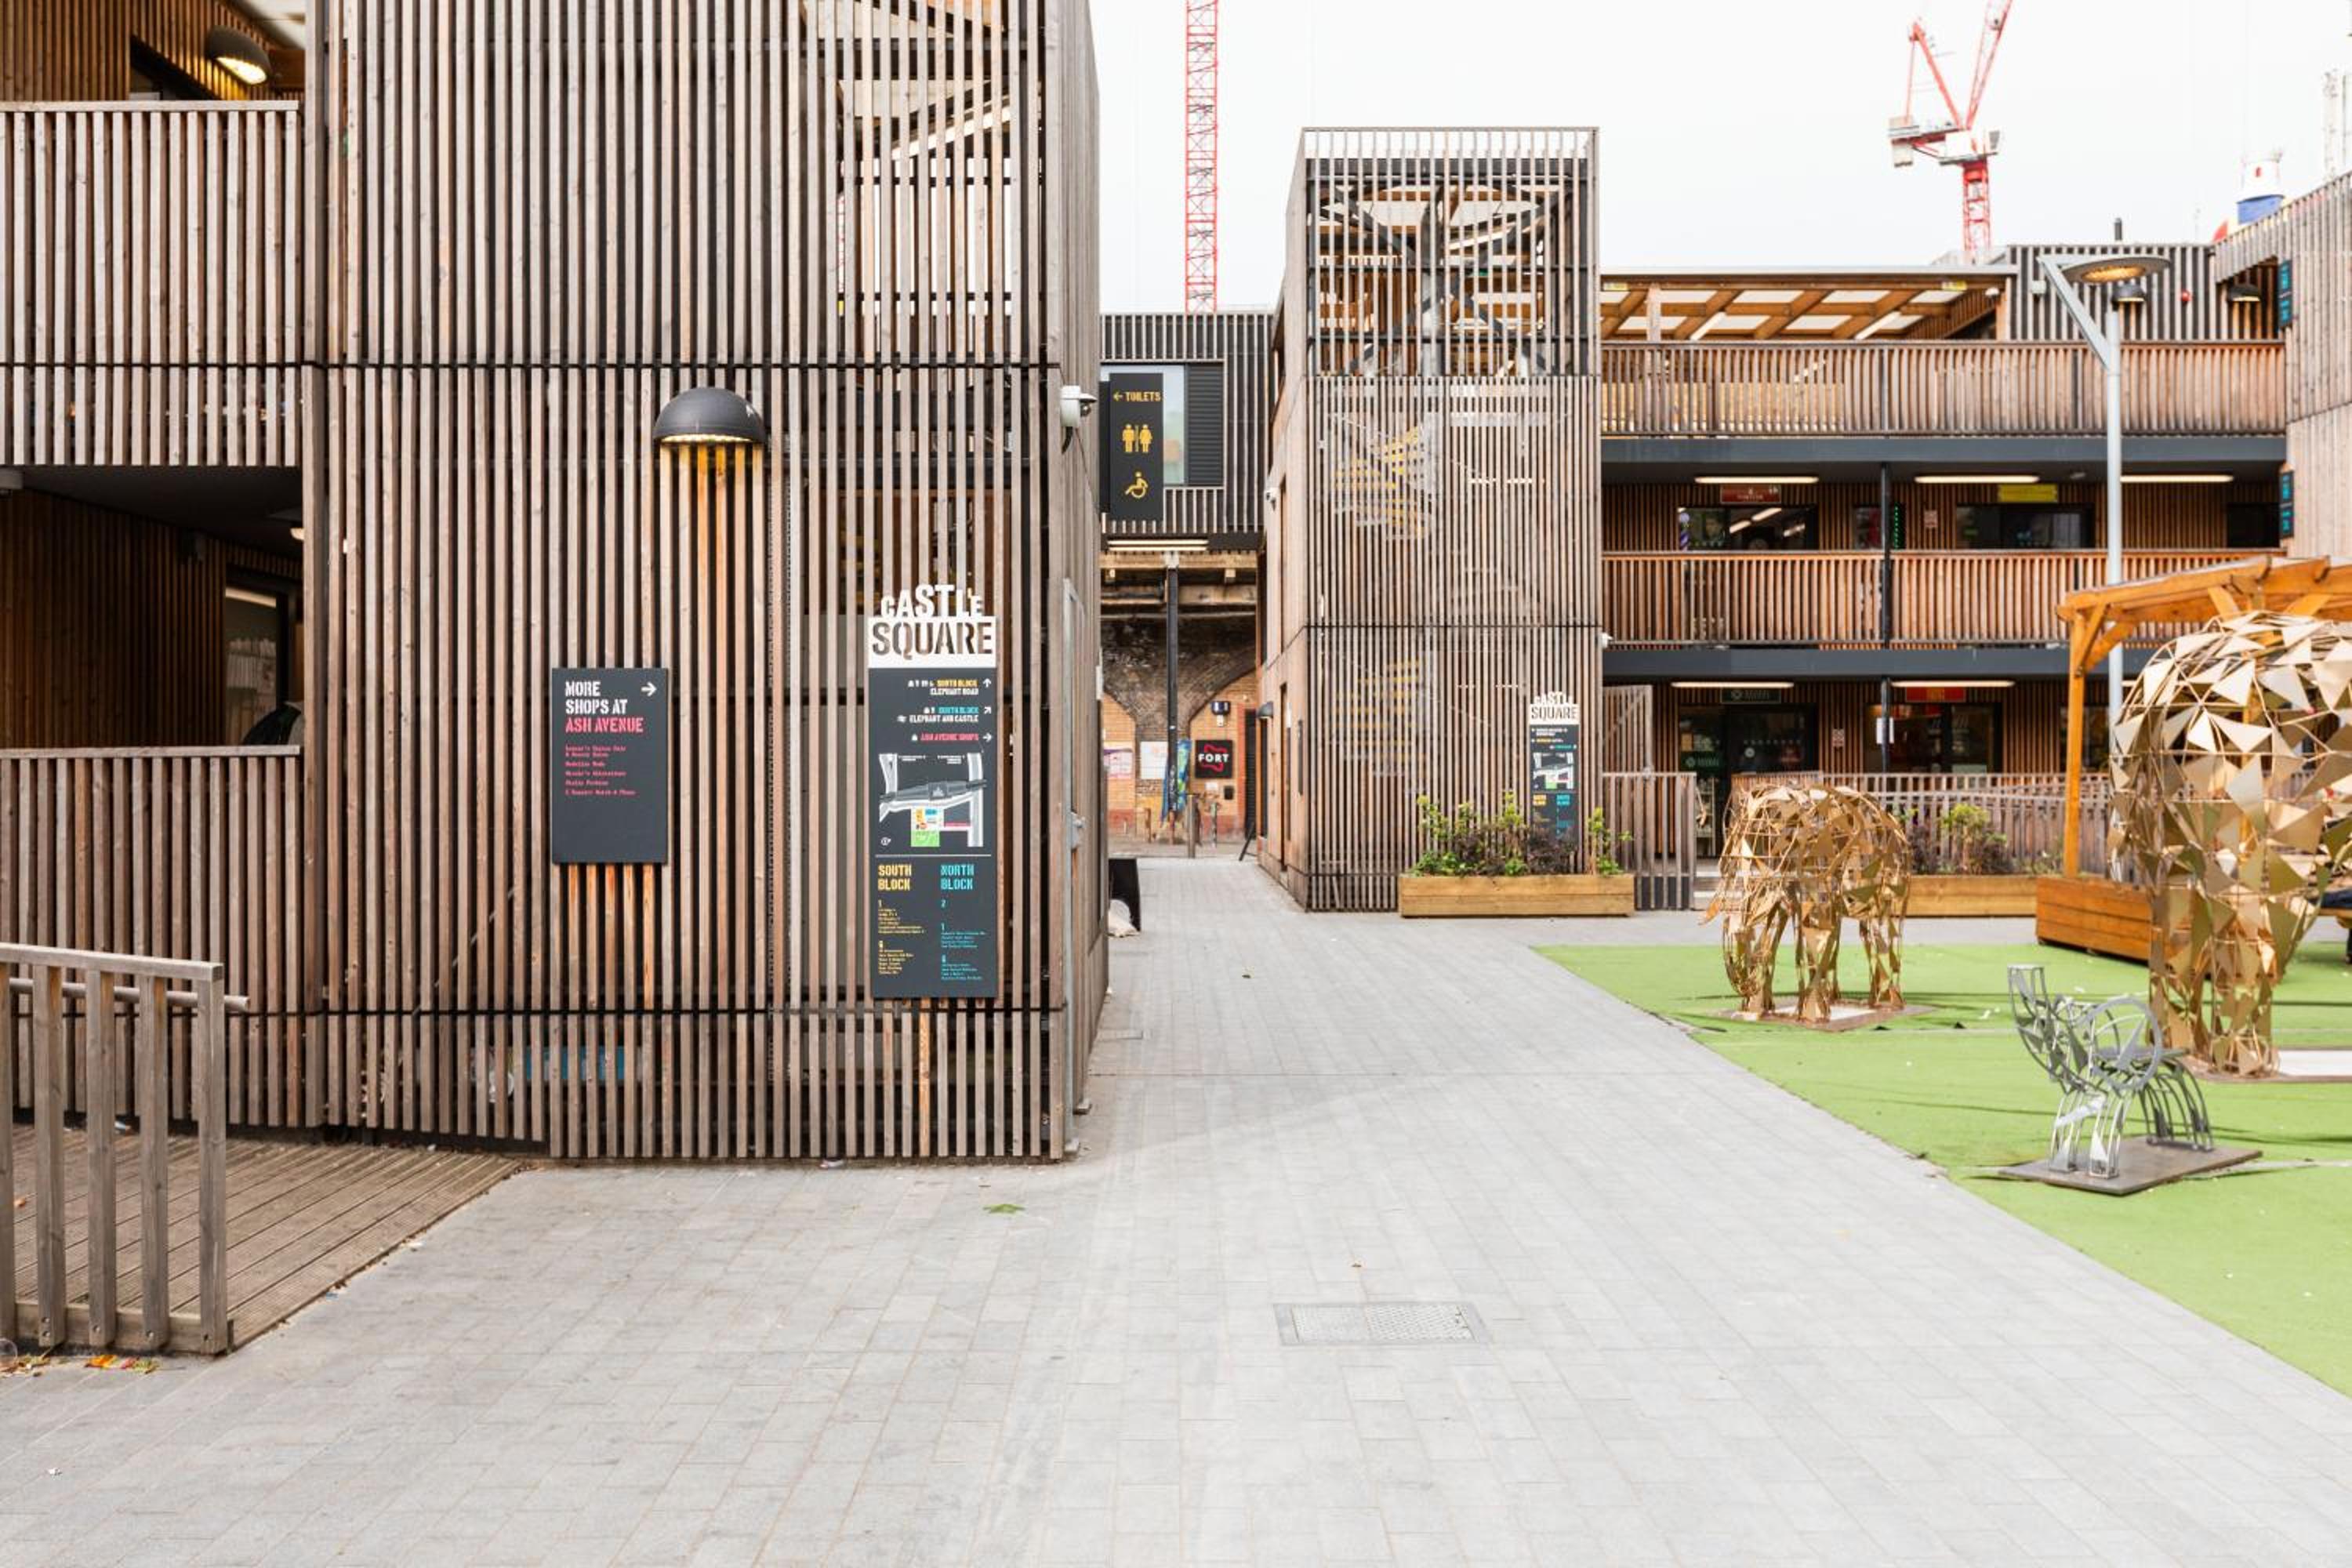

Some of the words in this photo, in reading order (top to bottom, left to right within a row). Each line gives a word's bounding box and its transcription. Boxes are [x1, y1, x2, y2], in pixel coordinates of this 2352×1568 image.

[1125, 391, 1161, 402] TOILETS
[880, 584, 984, 618] CASTLE
[872, 622, 993, 660] SQUARE
[564, 681, 601, 697] MORE
[565, 699, 609, 715] SHOPS
[612, 699, 628, 715] AT
[1531, 706, 1577, 720] SQUARE
[565, 717, 592, 733] ASH
[594, 717, 644, 733] AVENUE
[909, 714, 941, 723] ELEPHANT
[1198, 753, 1229, 763] FORT
[877, 864, 912, 877] SOUTH
[940, 864, 975, 876] NORTH
[877, 878, 911, 891] BLOCK
[940, 877, 974, 890] BLOCK
